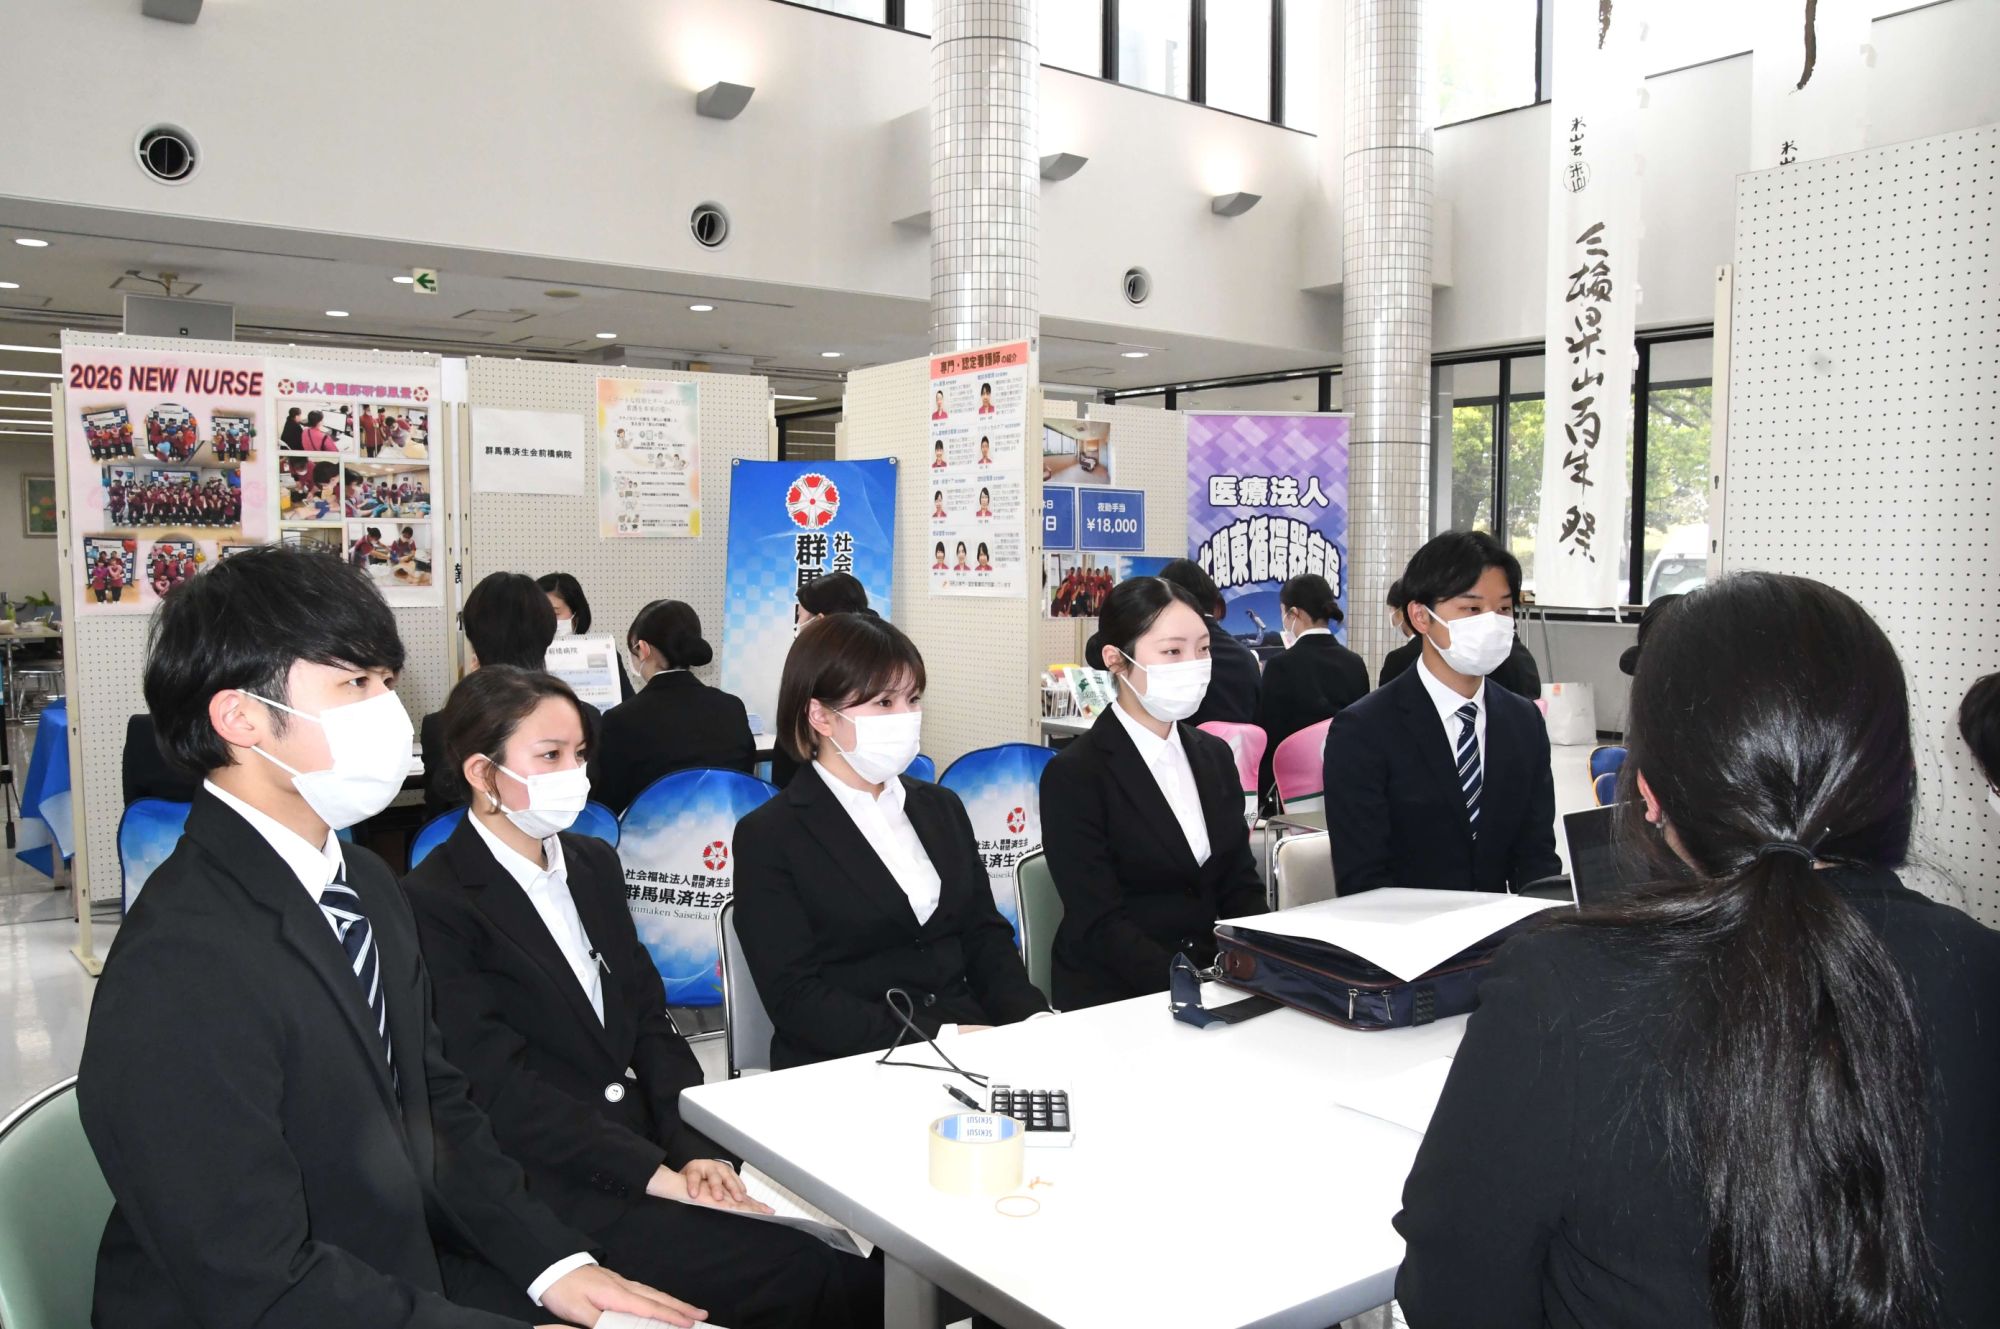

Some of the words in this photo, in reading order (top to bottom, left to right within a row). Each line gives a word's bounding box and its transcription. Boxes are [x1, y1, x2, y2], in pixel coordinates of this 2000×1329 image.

[70, 363, 123, 391] 2026
[128, 366, 179, 393] NEW
[185, 368, 264, 396] NURSE
[485, 446, 572, 459] 群馬県済生会前橋病院
[1210, 476, 1329, 508] 医療法人
[1097, 502, 1126, 513] 夜勤手当
[1087, 518, 1137, 533] ¥18,000
[625, 884, 734, 909] 群馬県済生会
[628, 905, 671, 917] unmaken
[967, 1116, 993, 1125] SEKISUI
[967, 1128, 993, 1137] SEKISUI
